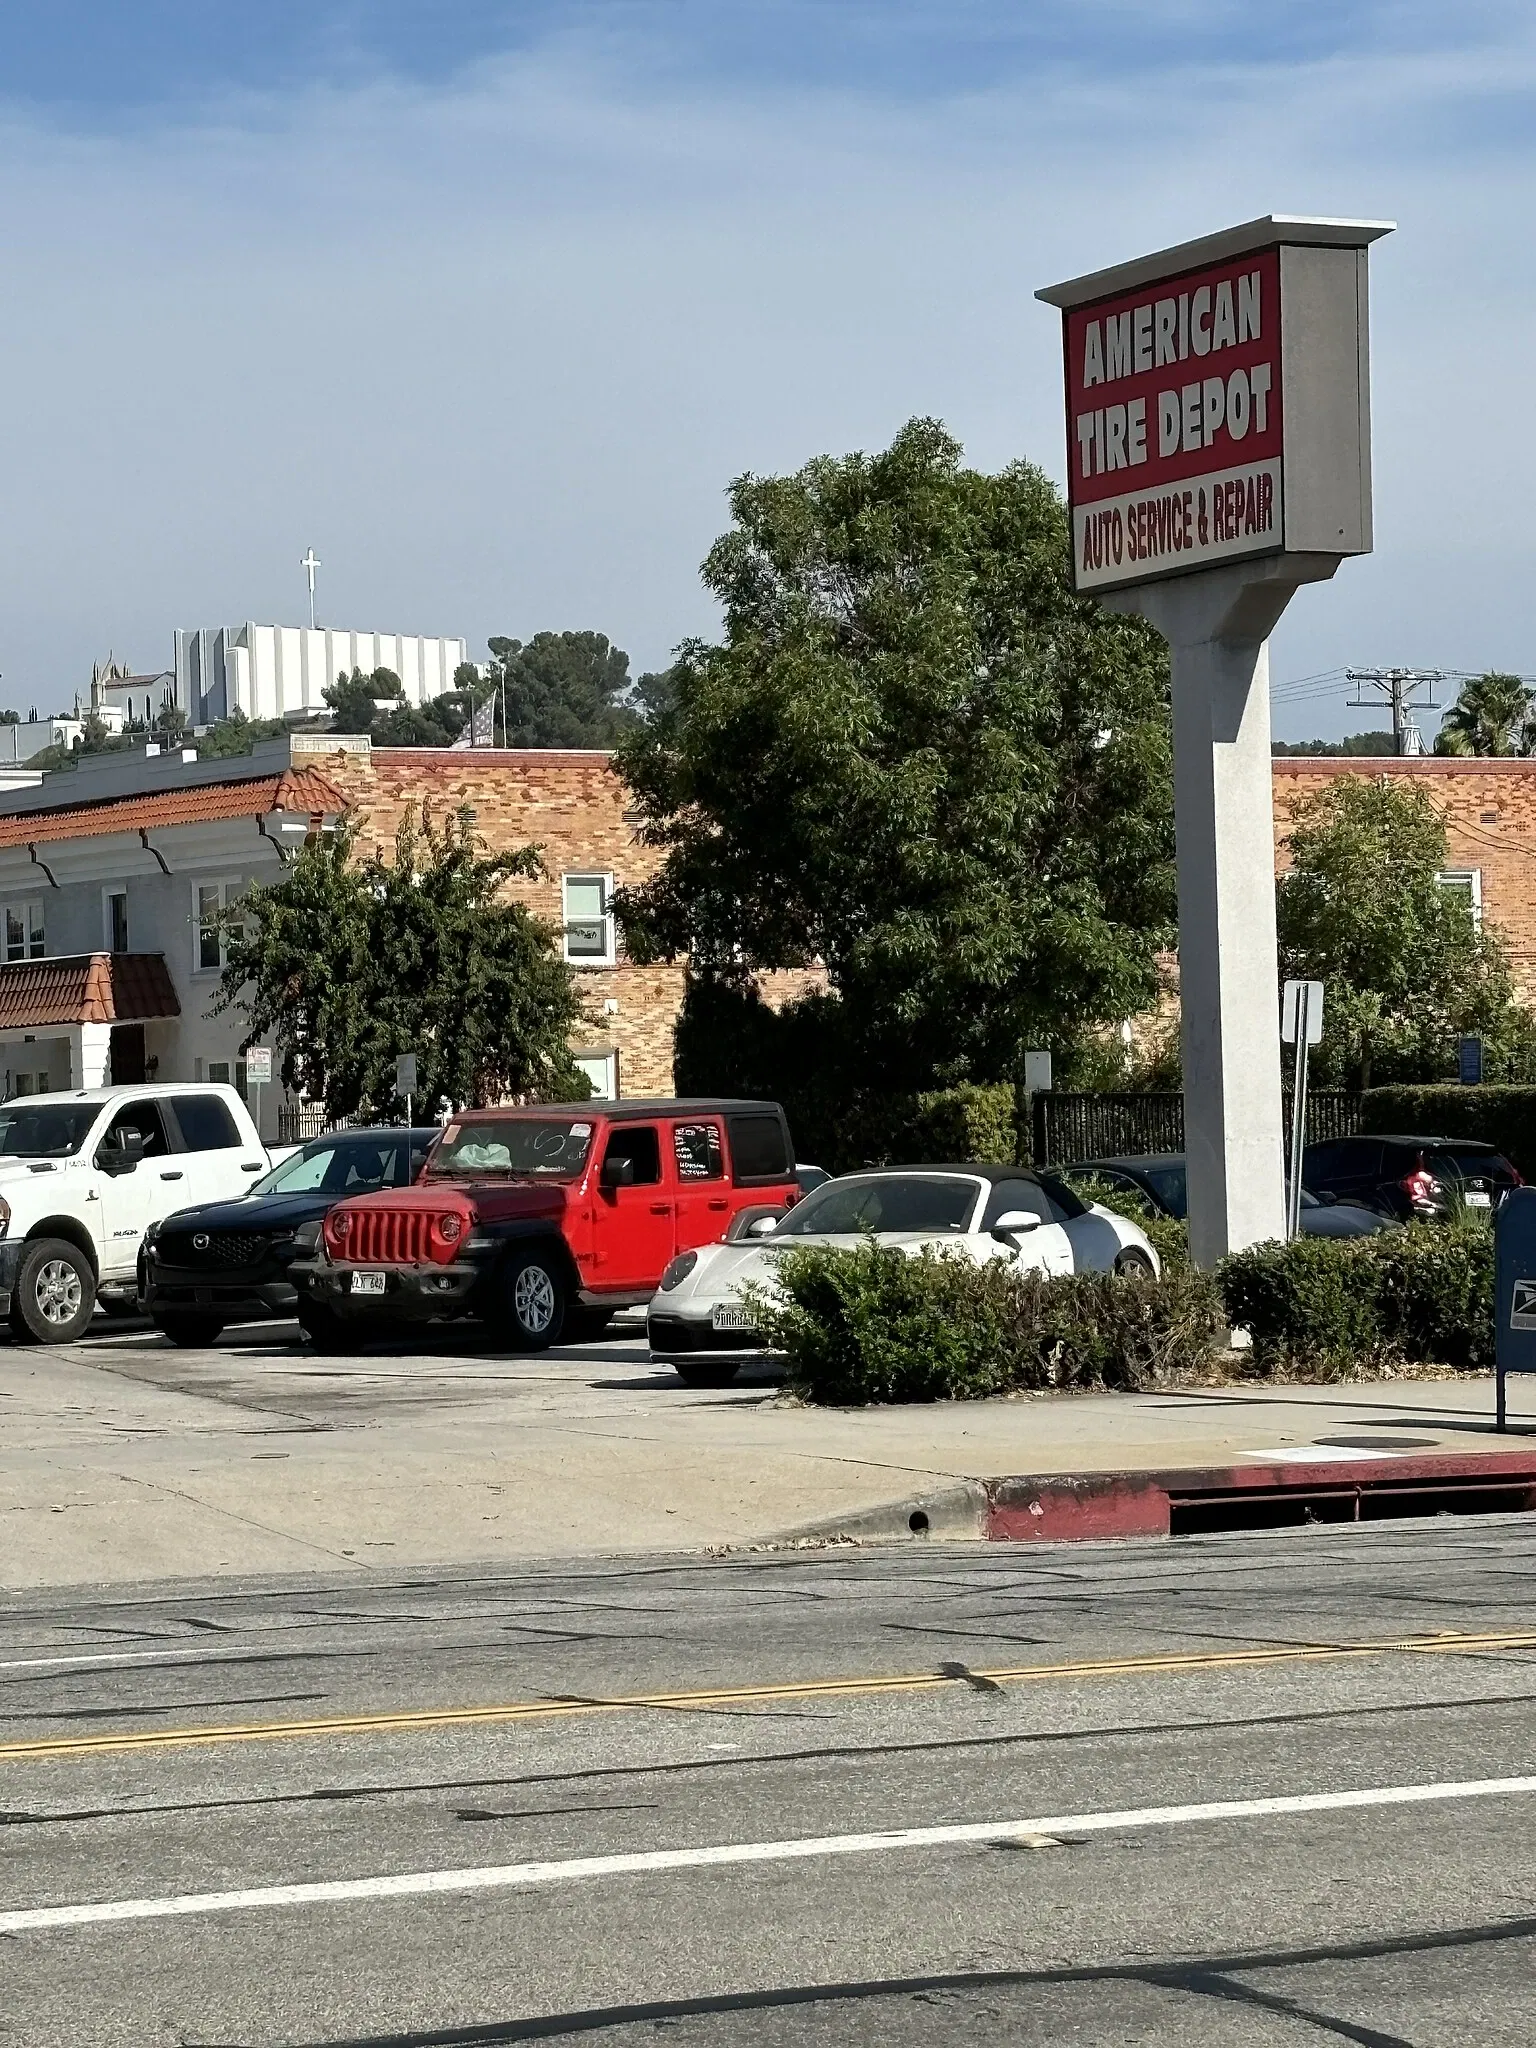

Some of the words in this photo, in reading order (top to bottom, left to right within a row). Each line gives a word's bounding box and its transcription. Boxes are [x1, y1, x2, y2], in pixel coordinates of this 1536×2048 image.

[1083, 270, 1261, 389] AMERICAN
[1076, 396, 1148, 479] TIRE
[1158, 362, 1272, 458] DEPOT
[1083, 507, 1123, 571] AUTO
[1127, 490, 1193, 564] SERVICE
[1198, 487, 1209, 547] &
[1213, 472, 1273, 542] REPAIR
